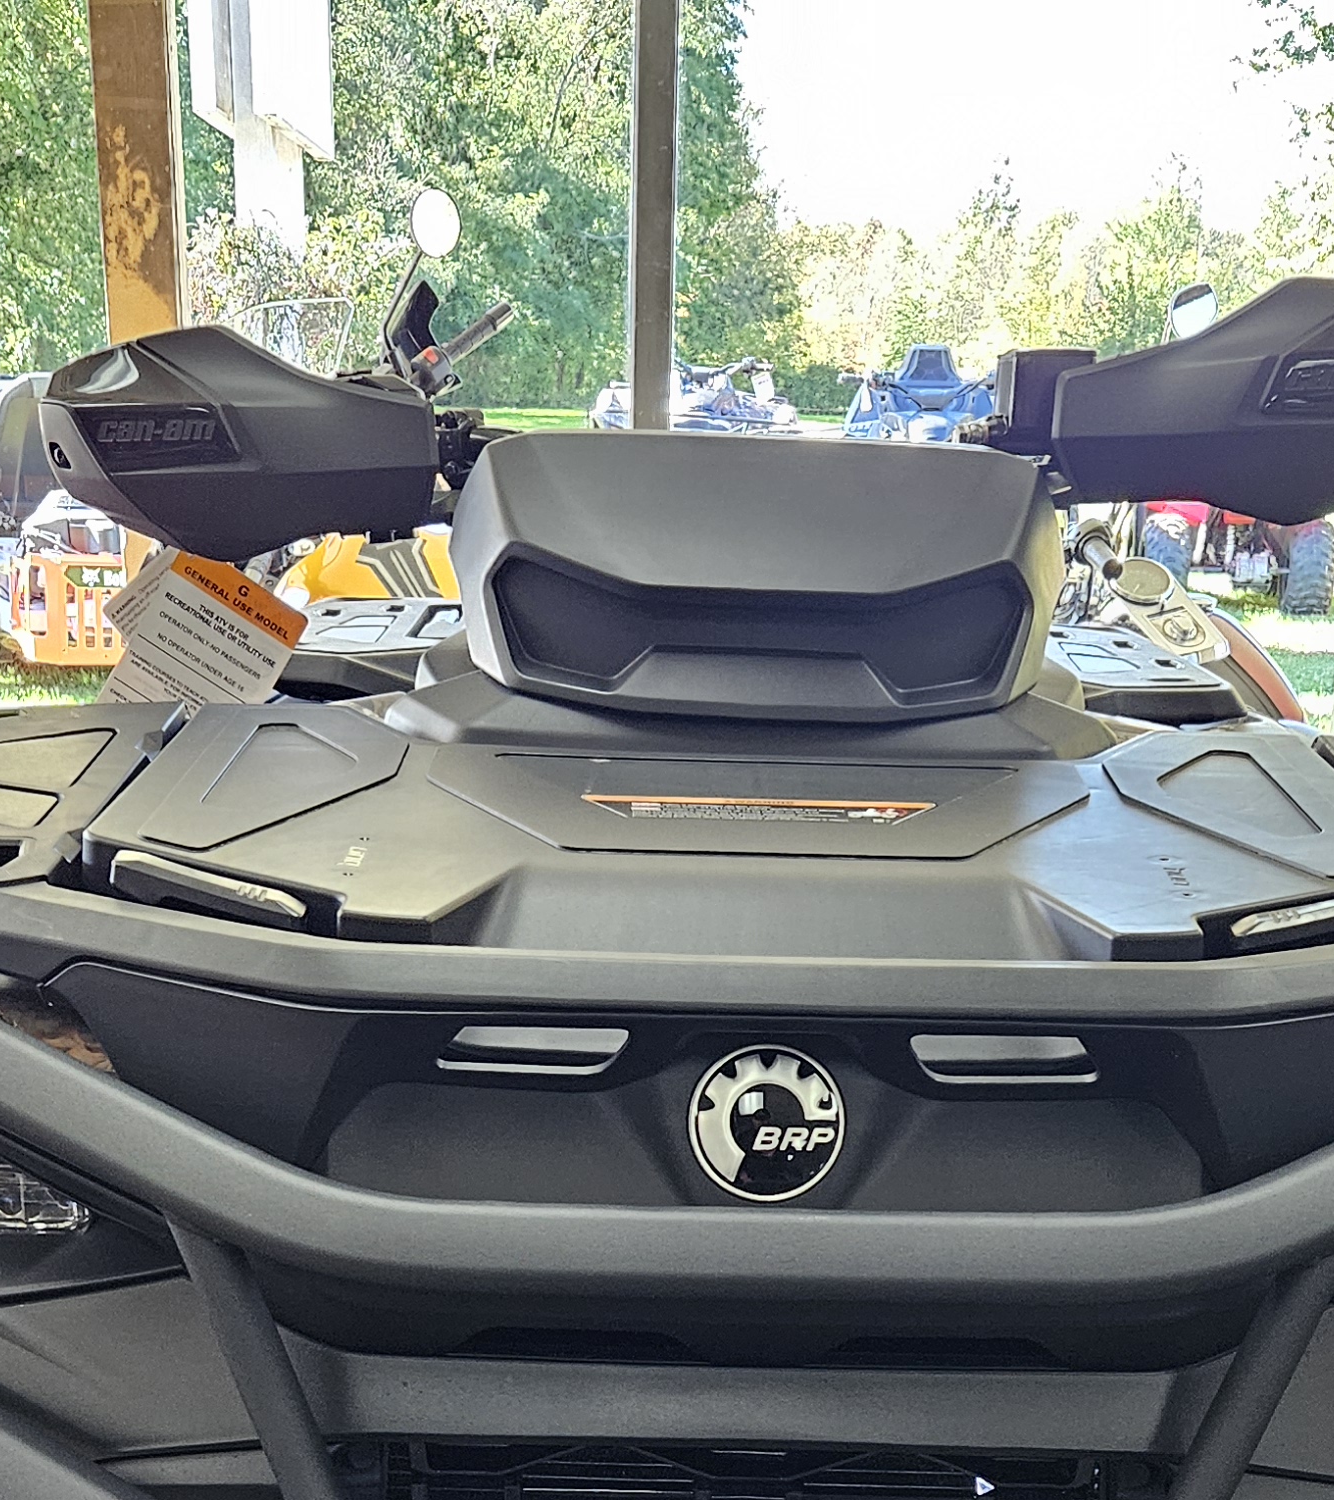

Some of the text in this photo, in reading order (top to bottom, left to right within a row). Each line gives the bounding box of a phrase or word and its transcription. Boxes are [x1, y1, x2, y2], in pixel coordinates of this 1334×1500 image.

[97, 418, 216, 443] can-am
[182, 566, 290, 639] GENERAL USE MODEL
[236, 584, 250, 597] G
[163, 592, 275, 667] RECREATIONAL USE OR UTILITY USE
[198, 604, 214, 618] THIS
[214, 615, 228, 626] ATV
[235, 628, 249, 639] FOR
[156, 633, 167, 642] NO
[166, 640, 201, 664] OPERATOR
[201, 662, 222, 678] UNDER
[223, 675, 236, 686] AGE
[158, 611, 193, 636] OPERATOR
[219, 650, 261, 679] PASSENGERS
[752, 1126, 835, 1151] BRP
